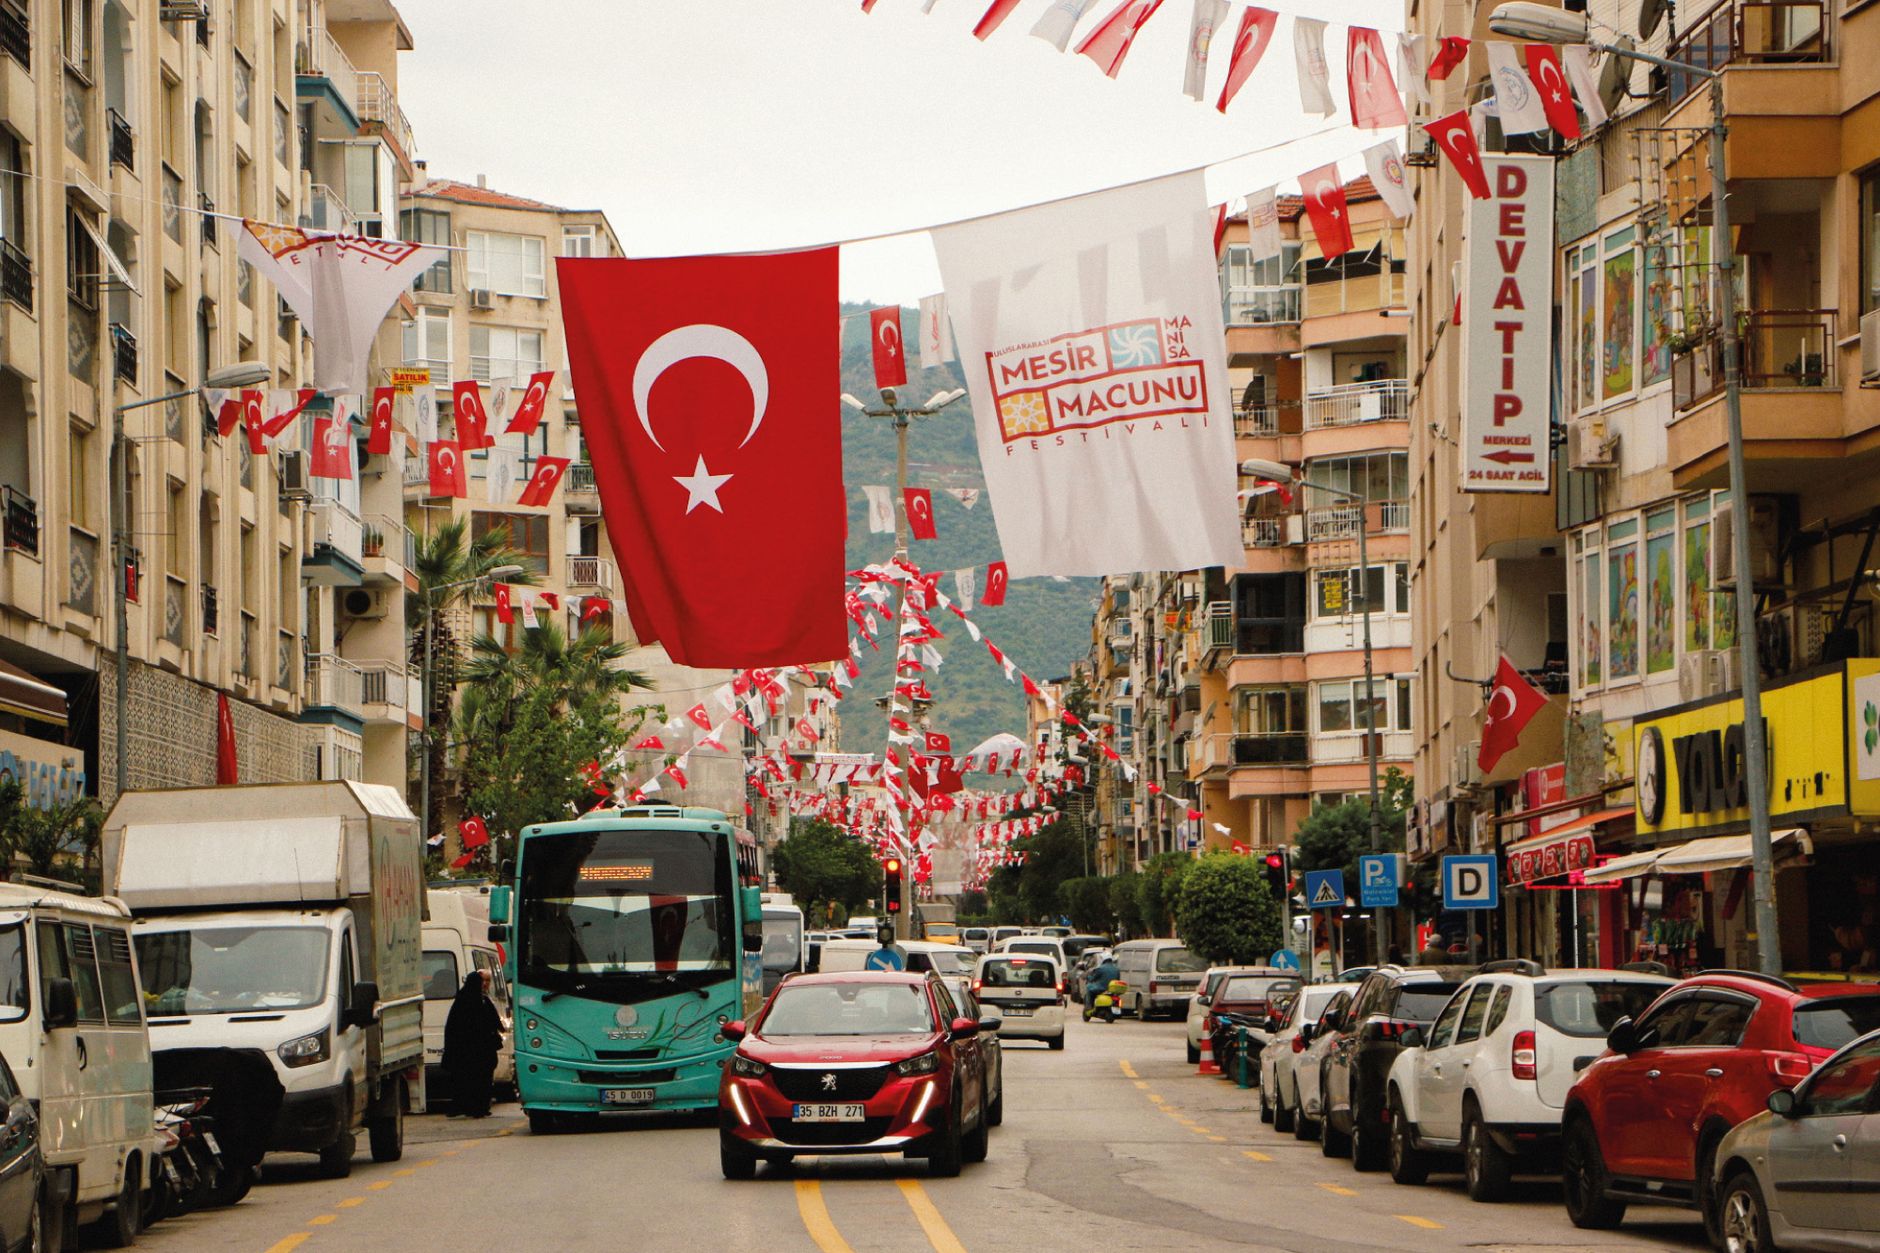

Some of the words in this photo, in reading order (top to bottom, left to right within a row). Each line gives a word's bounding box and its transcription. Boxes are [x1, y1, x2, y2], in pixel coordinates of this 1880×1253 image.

[1000, 341, 1098, 385] MESİR
[1056, 375, 1197, 419] MACUNU
[1006, 413, 1209, 457] FESTİVALİ
[1483, 433, 1532, 446] MERKEZİ
[1469, 470, 1484, 480] 24
[1486, 470, 1515, 481] SAAT
[1364, 859, 1385, 887] P
[1458, 867, 1482, 897] D
[800, 1105, 812, 1117] 35
[818, 1105, 838, 1117] BZH
[845, 1105, 863, 1117] 271
